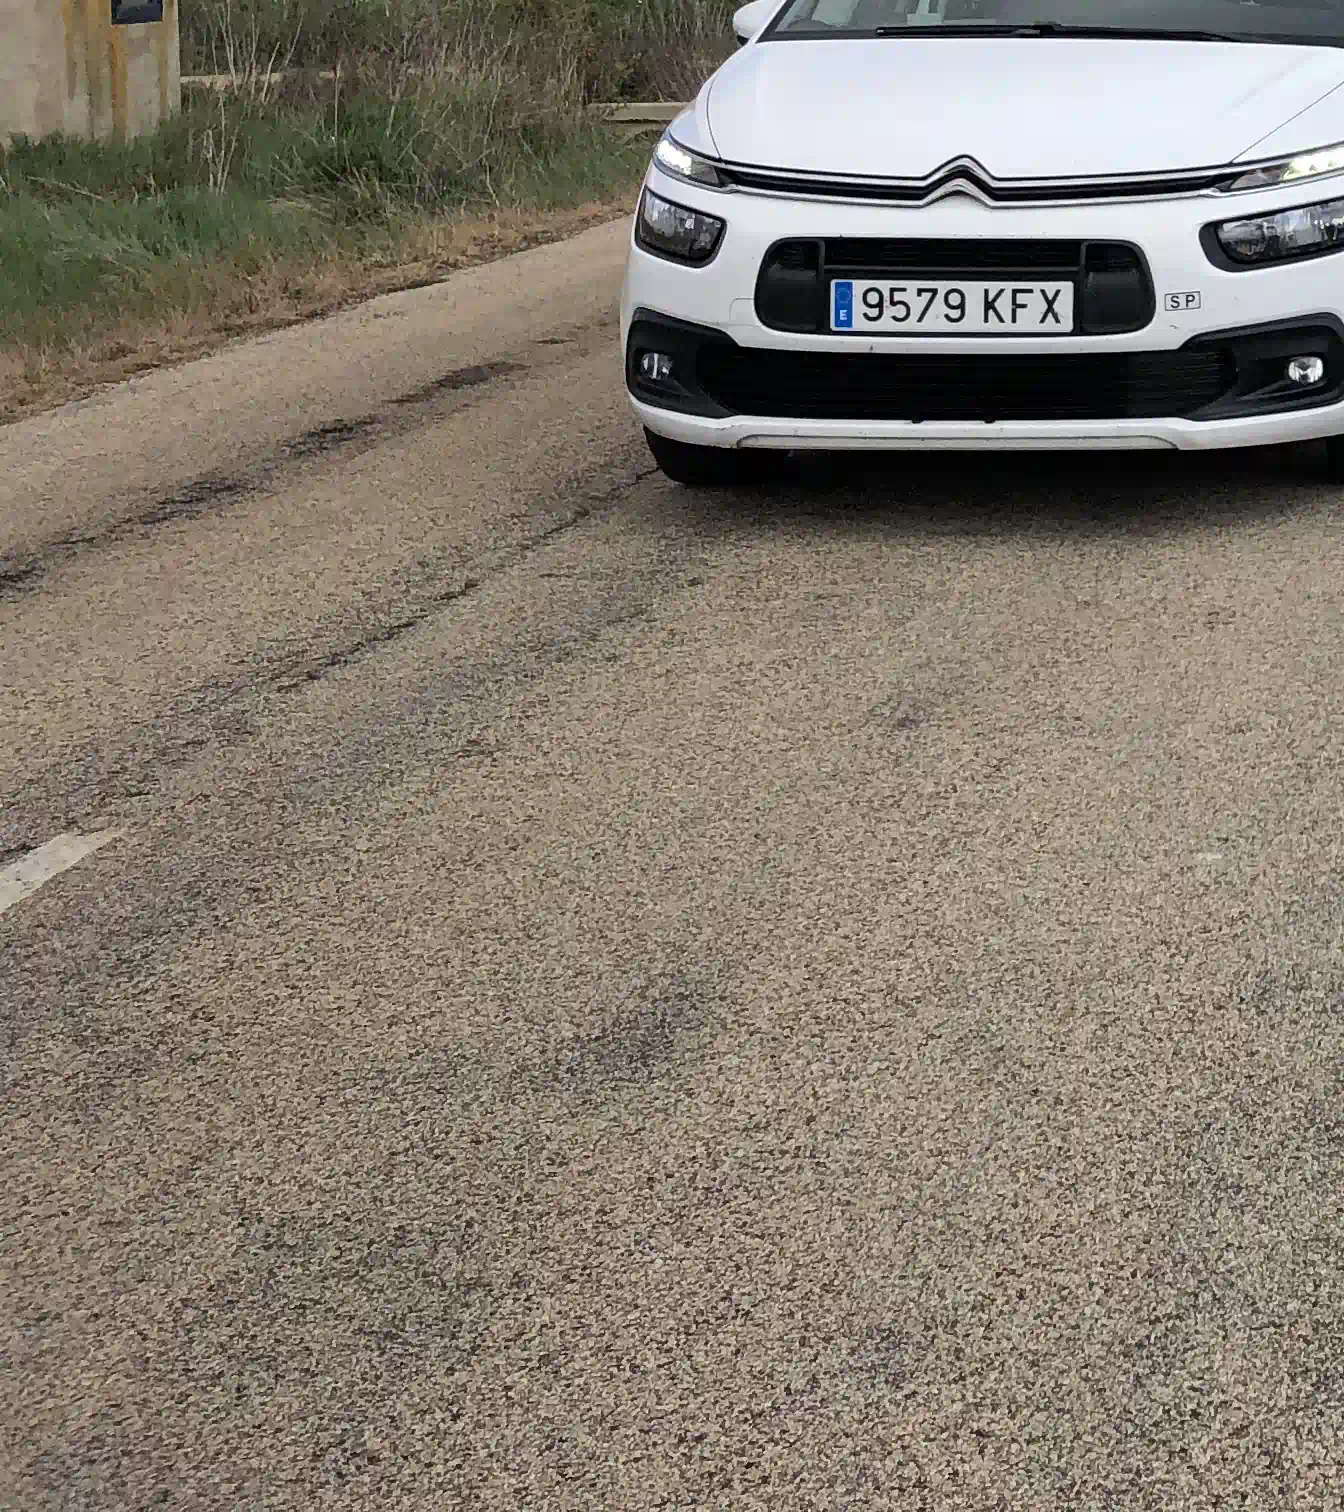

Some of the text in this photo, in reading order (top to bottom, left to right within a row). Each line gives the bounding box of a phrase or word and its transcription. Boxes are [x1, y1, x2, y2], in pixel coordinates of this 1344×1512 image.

[839, 310, 847, 320] E
[861, 287, 1062, 324] 9579 KFX
